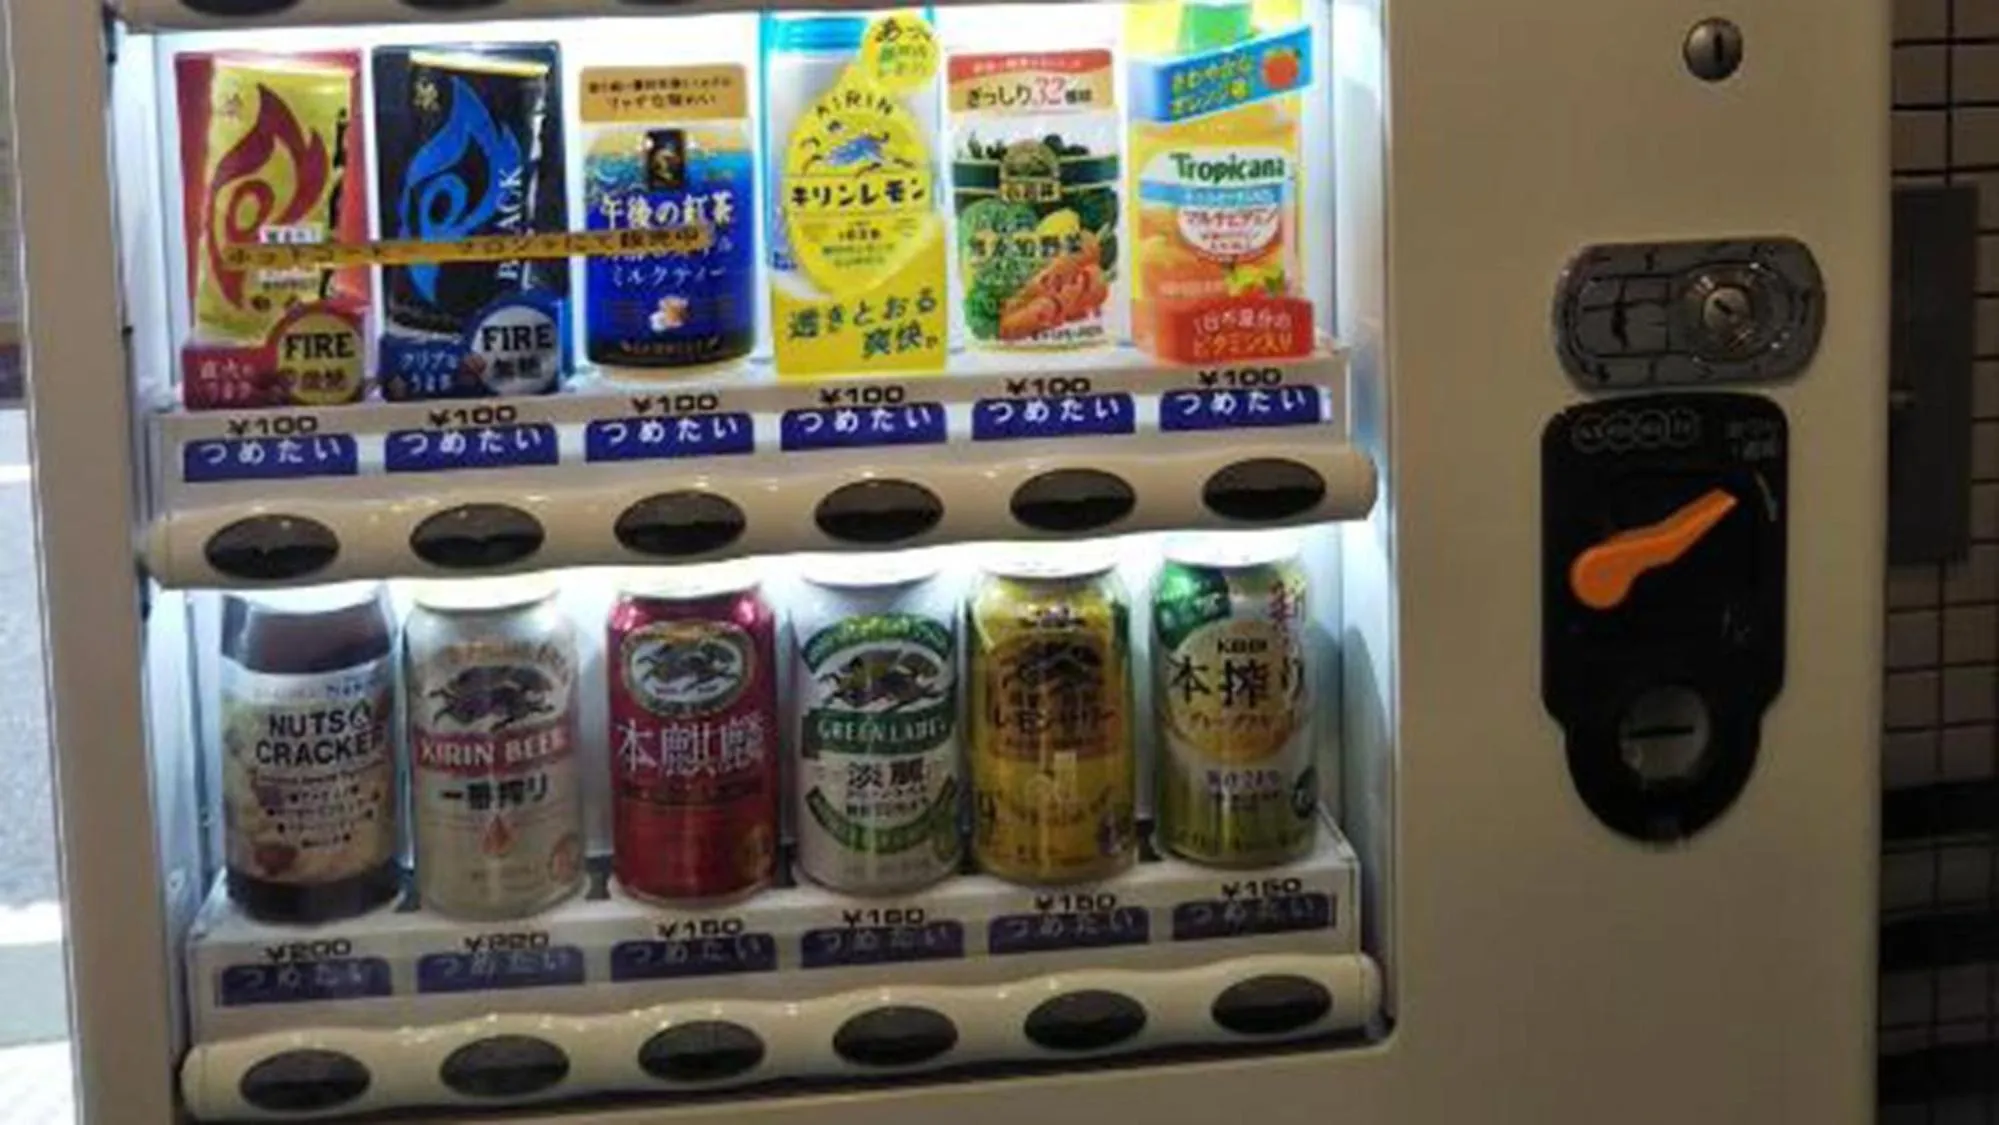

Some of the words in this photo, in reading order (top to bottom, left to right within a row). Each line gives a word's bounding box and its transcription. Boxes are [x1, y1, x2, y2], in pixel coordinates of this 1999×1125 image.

[815, 89, 895, 118] KIRIN
[1171, 151, 1286, 183] Tropicana
[790, 178, 926, 207] キリンレモン
[283, 331, 355, 360] FIRE
[482, 323, 554, 352] FIRE
[1006, 376, 1092, 397] ¥100
[1199, 367, 1282, 387] ¥100
[631, 394, 719, 413] ¥100
[819, 385, 905, 405] ¥100
[1177, 388, 1306, 416] つめたい
[428, 405, 517, 427] ¥100
[797, 406, 932, 433] つめたい
[988, 398, 1120, 423] つめたい
[228, 415, 318, 437] ¥100
[602, 416, 739, 445] つめたい
[200, 438, 342, 465] つめたい
[403, 427, 541, 455] つめたい
[816, 717, 883, 743] GREEN
[419, 740, 496, 768] KIRIN
[504, 729, 569, 764] BEER
[613, 713, 765, 777] 本麒麟
